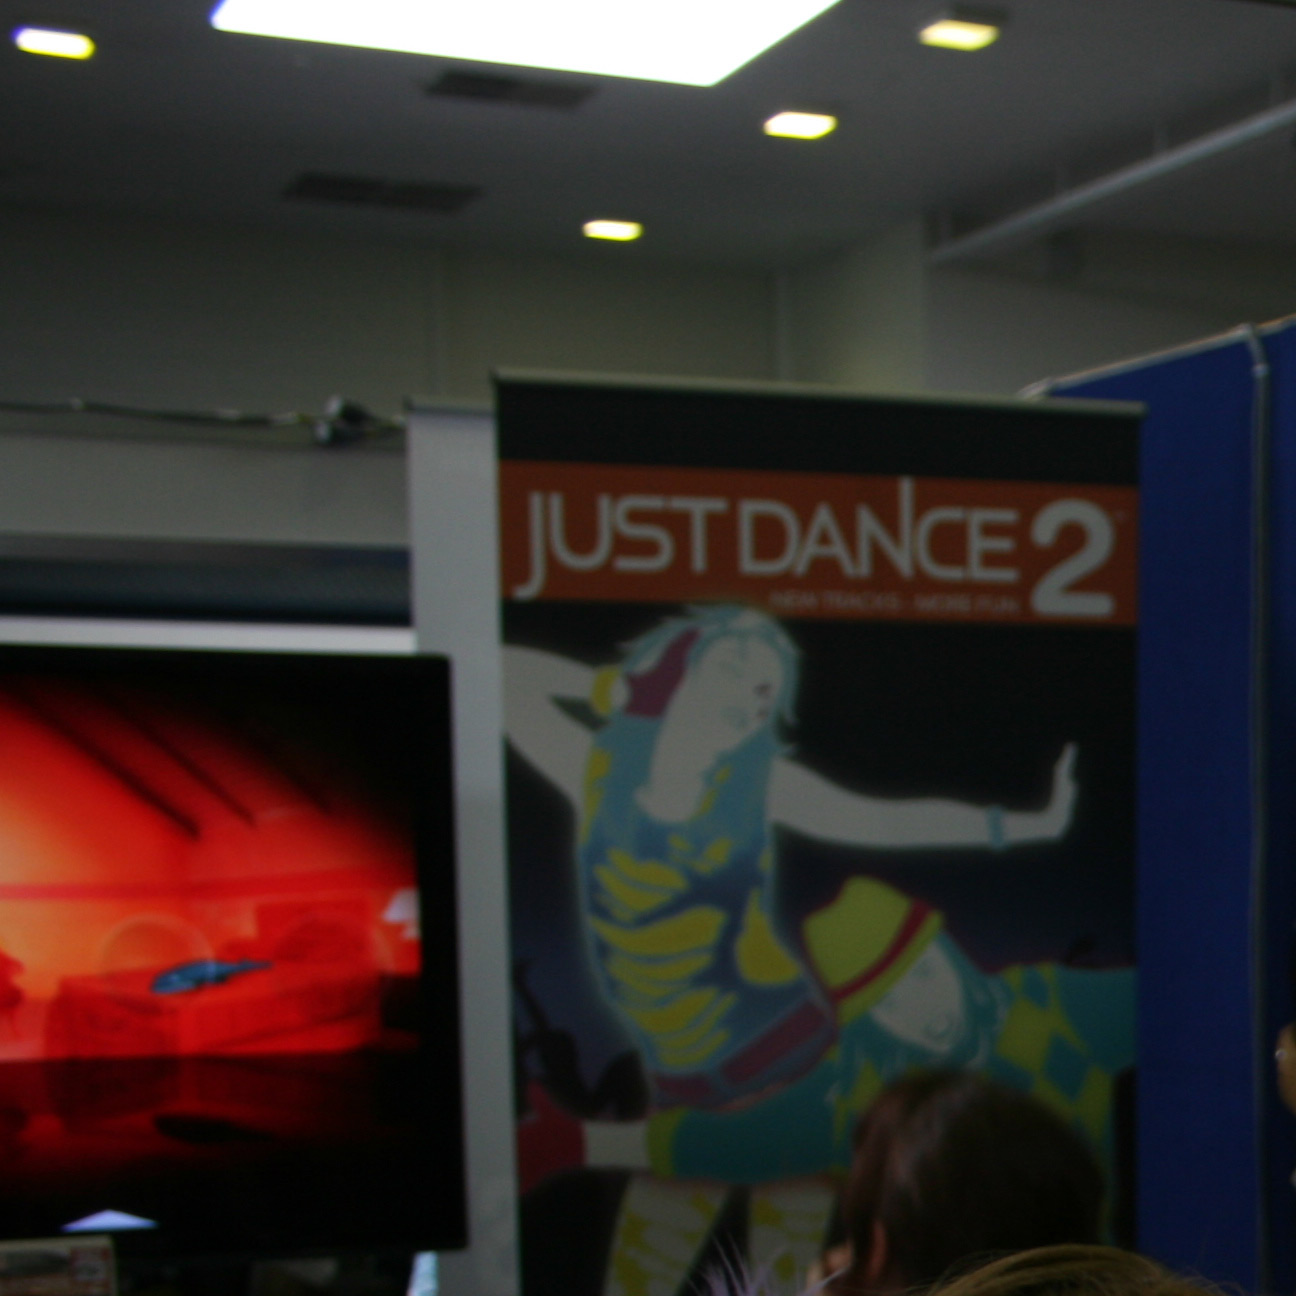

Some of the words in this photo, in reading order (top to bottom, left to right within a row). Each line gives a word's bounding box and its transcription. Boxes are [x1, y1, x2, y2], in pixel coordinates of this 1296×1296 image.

[512, 490, 729, 600] JUST
[738, 475, 1021, 583] DANCE
[1030, 498, 1116, 617] 2
